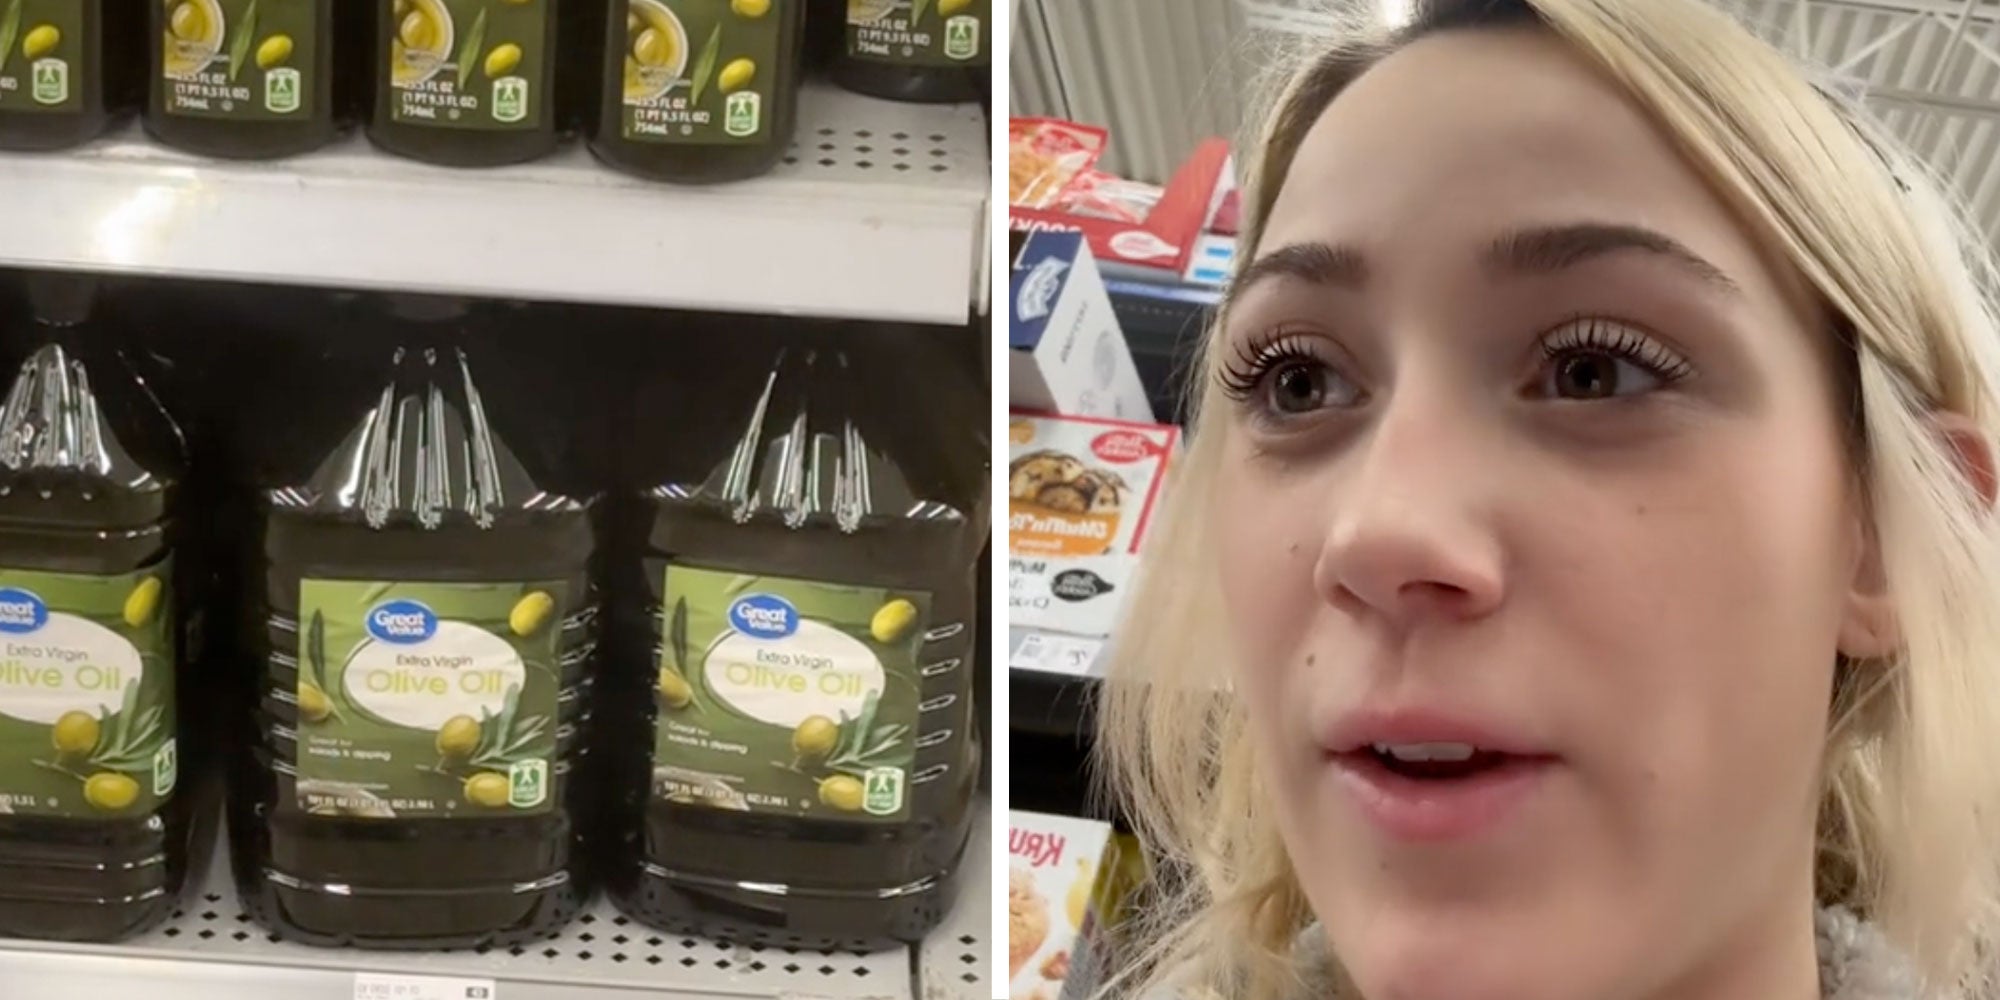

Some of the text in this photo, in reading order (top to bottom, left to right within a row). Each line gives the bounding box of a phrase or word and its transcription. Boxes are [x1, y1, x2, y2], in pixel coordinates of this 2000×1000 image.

[374, 609, 425, 627] Great
[736, 602, 787, 622] Great
[386, 624, 425, 636] Value
[748, 618, 787, 632] Value
[6, 643, 89, 662] Extra Virgin
[396, 654, 473, 669] Extra Virgin
[757, 649, 833, 669] Extra Virgin
[0, 660, 121, 691] live Oil
[366, 668, 503, 695] Olive Oil
[725, 662, 862, 697] Olive Oil
